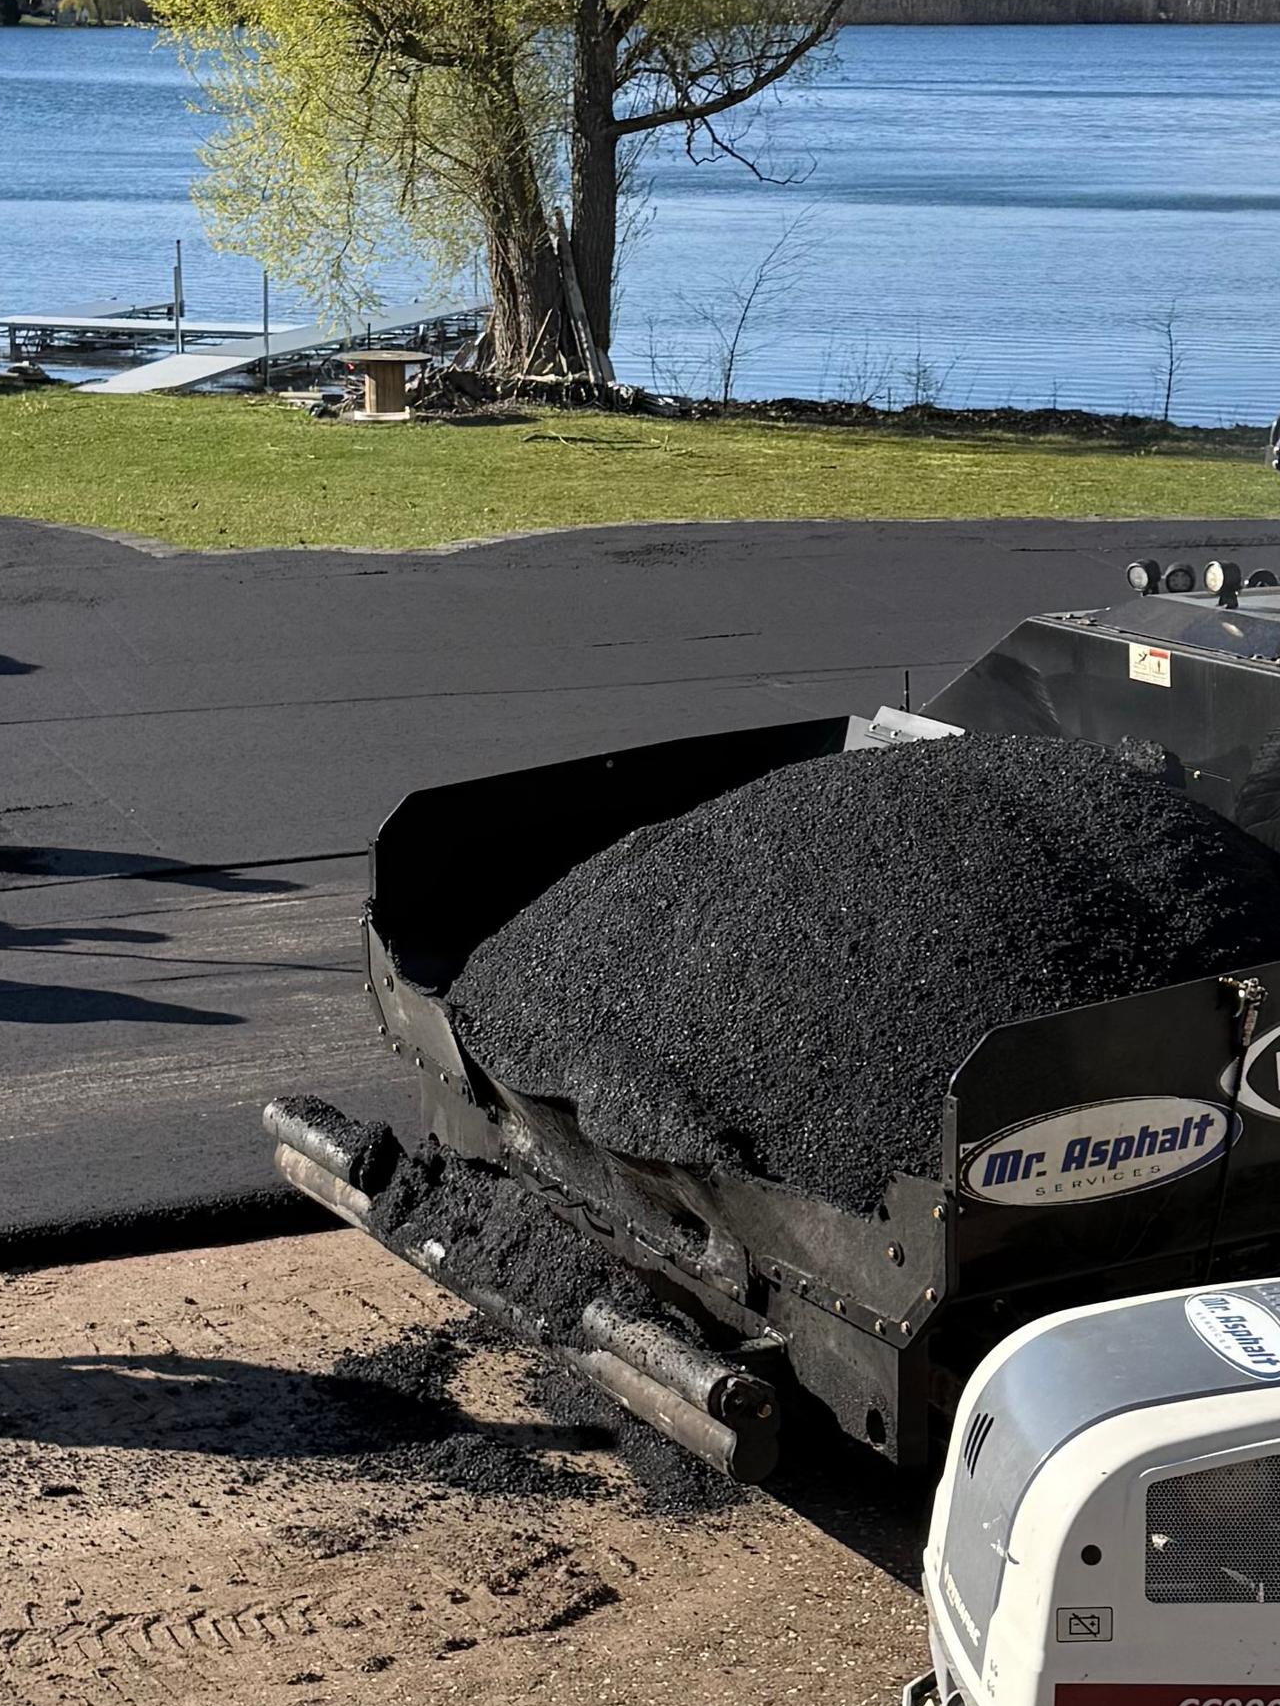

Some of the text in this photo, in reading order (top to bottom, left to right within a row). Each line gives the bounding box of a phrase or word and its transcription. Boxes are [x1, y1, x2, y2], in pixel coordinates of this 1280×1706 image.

[981, 1112, 1215, 1188] Mr. Asphalt
[1035, 1165, 1161, 1196] SERVICES
[1198, 1296, 1280, 1368] Mr. Asphalt
